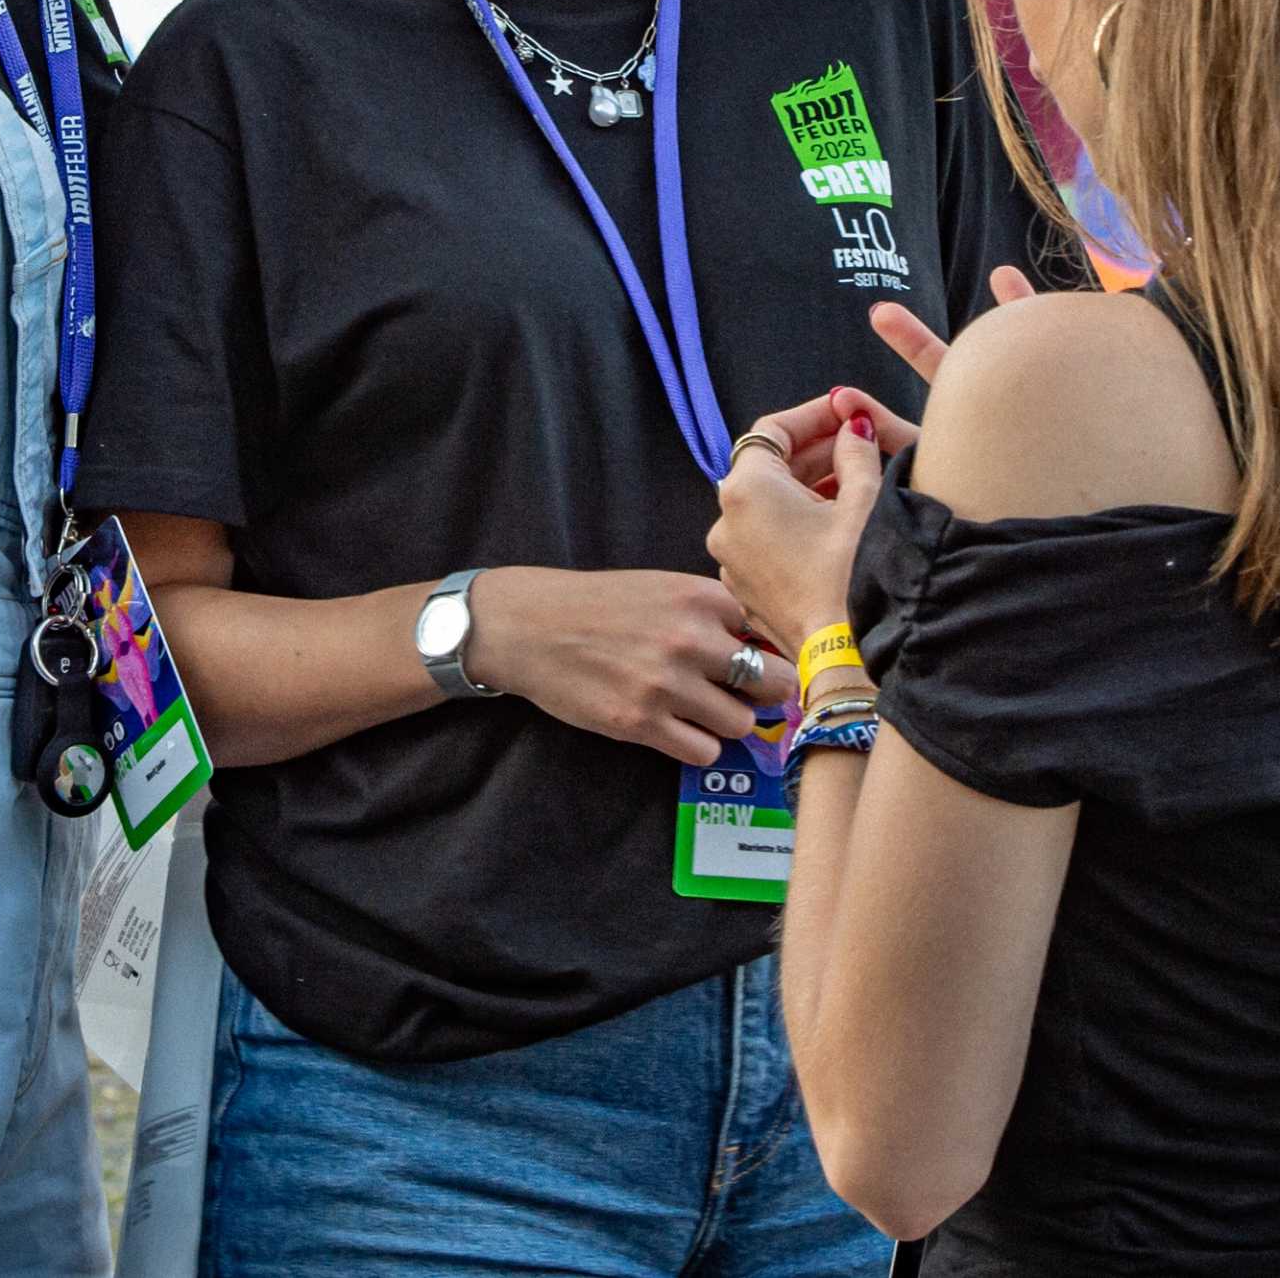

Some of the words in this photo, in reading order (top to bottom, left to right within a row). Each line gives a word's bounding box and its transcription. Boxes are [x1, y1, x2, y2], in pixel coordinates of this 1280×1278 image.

[783, 89, 858, 130] LAUT
[792, 118, 868, 143] FEUER
[810, 139, 867, 161] 2025
[60, 115, 91, 225] LAUTFEUER
[800, 160, 893, 199] CREW
[832, 208, 896, 254] 40
[832, 247, 910, 276] FESTIVALS
[854, 272, 878, 287] SEIT
[696, 802, 755, 828] CREW
